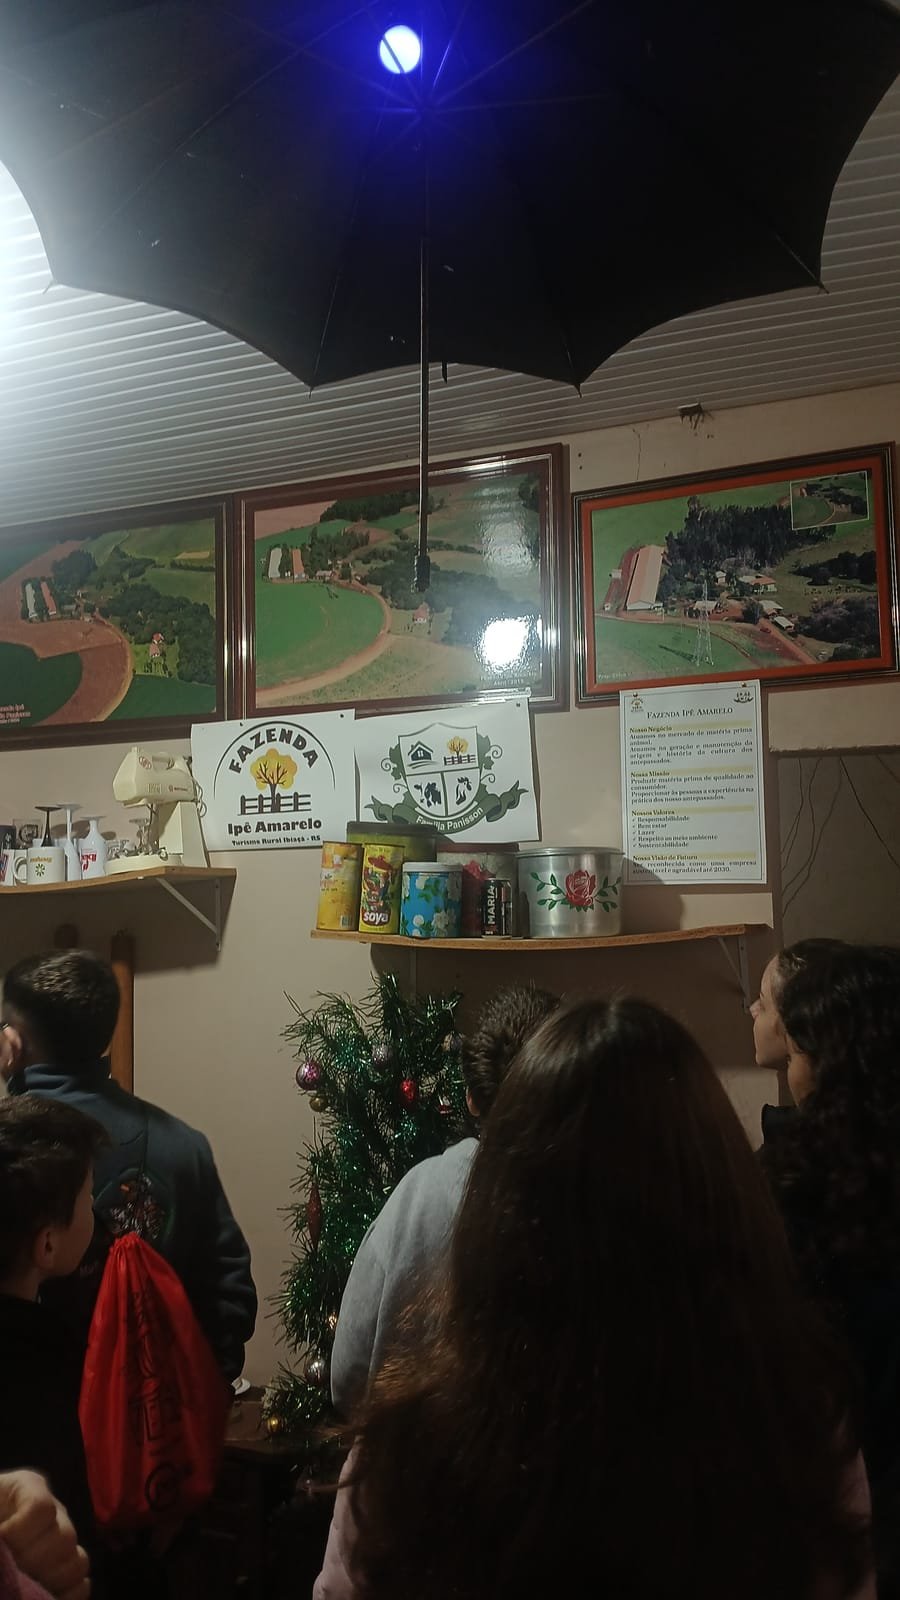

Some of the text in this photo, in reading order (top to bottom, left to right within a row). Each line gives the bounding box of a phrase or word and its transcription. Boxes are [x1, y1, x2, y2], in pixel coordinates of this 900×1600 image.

[648, 725, 673, 733] Negócio
[733, 727, 753, 735] prima
[229, 727, 319, 774] FAZENDA
[669, 743, 694, 751] geração
[702, 740, 743, 749] manutenção
[710, 747, 736, 755] cultura
[683, 775, 703, 783] prima
[713, 773, 745, 782] qualidade
[631, 790, 670, 798] Proporcionar
[707, 786, 745, 795] experiência
[652, 808, 675, 816] Valores
[447, 806, 485, 831] Panisson
[638, 815, 689, 823] Responsabilidade
[227, 817, 322, 837] Ipê Amarelo
[231, 839, 261, 847] Turismo
[261, 837, 281, 845] Rural
[638, 835, 665, 843] Respeito
[728, 860, 757, 868] empresa
[672, 866, 703, 874] agradável
[487, 886, 496, 925] MARIA
[363, 910, 389, 925] soya
